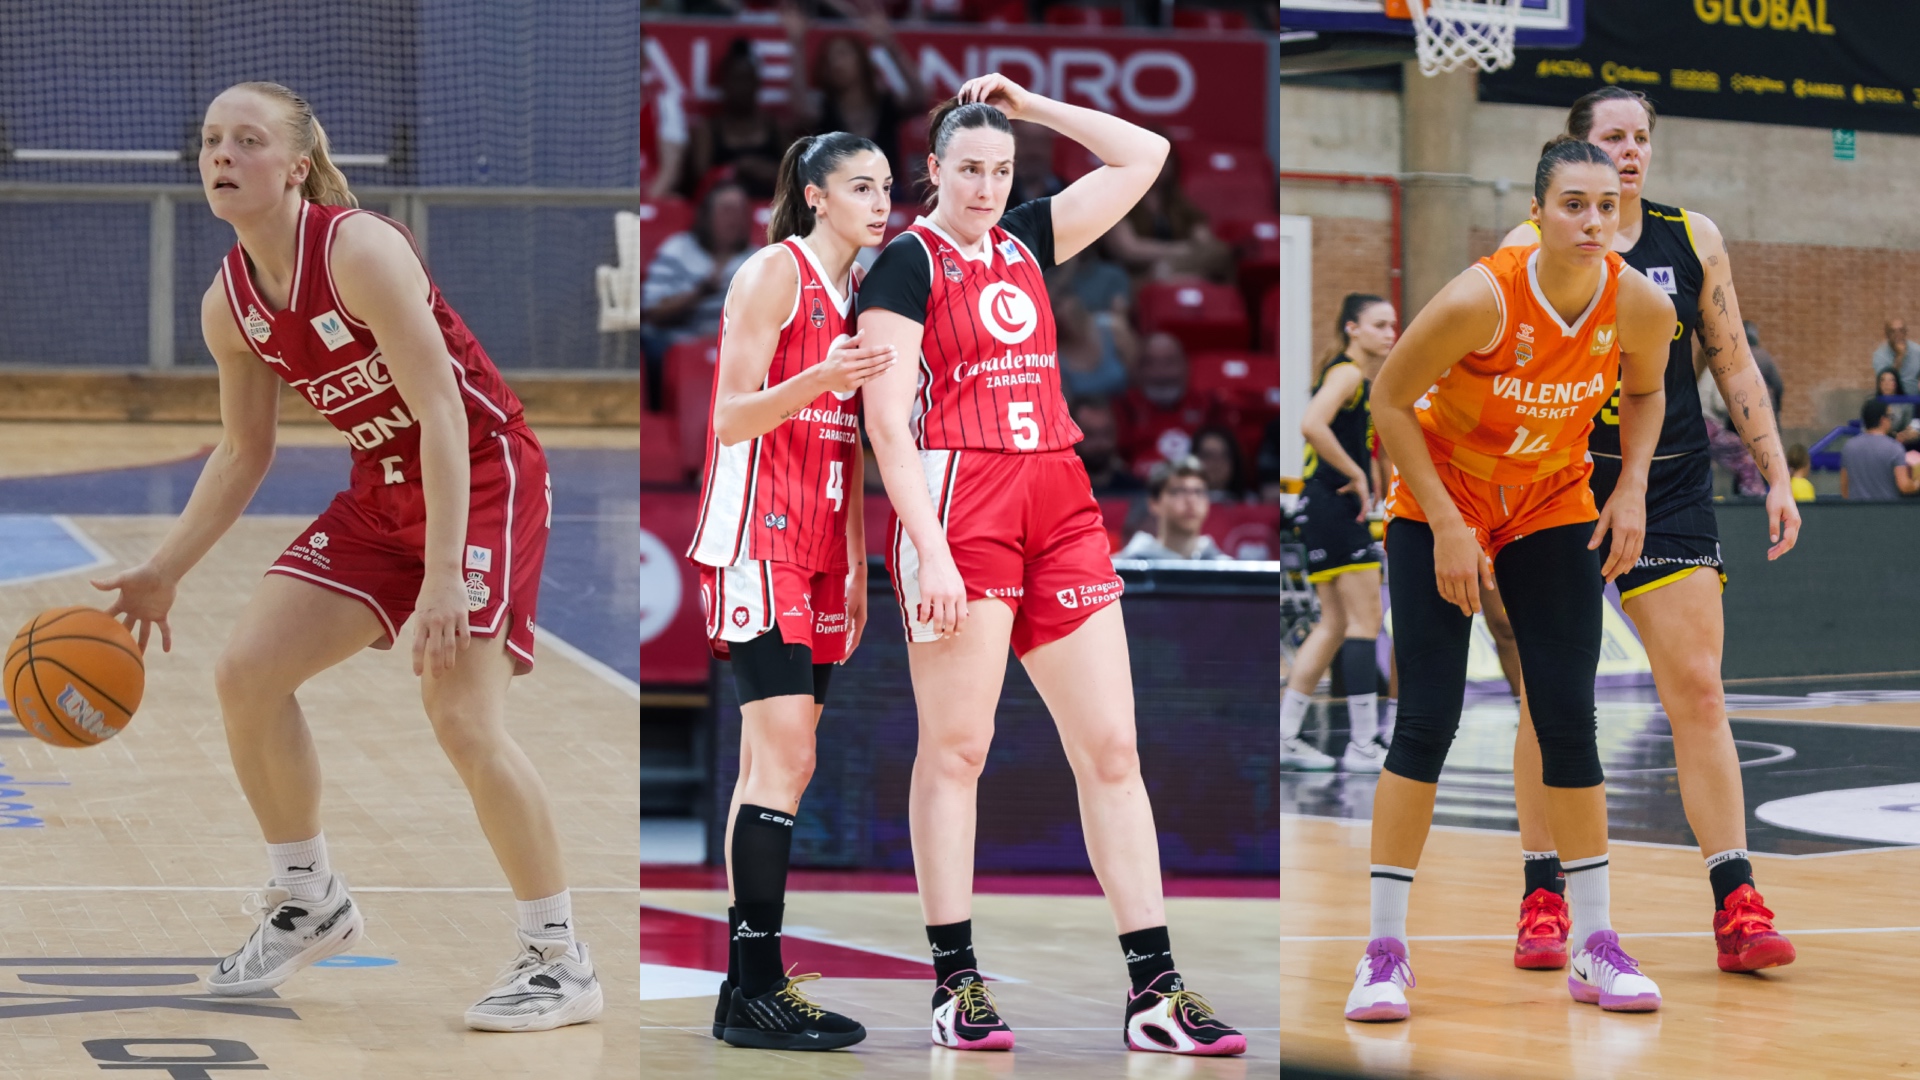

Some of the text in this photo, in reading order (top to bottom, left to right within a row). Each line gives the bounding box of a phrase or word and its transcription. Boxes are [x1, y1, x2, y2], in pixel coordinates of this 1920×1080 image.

[1694, 0, 1836, 35] GLOBAL
[986, 373, 1042, 389] ZARAGOZA
[1493, 373, 1605, 404] VALENCIA
[1515, 404, 1579, 419] BASKET
[1008, 402, 1039, 449] 5
[818, 428, 856, 444] ZARAGOZA
[1503, 425, 1551, 455] 14
[826, 461, 844, 512] 4
[310, 549, 331, 564] Brava
[312, 558, 333, 571] Giron
[1079, 580, 1120, 595] Zaragoza
